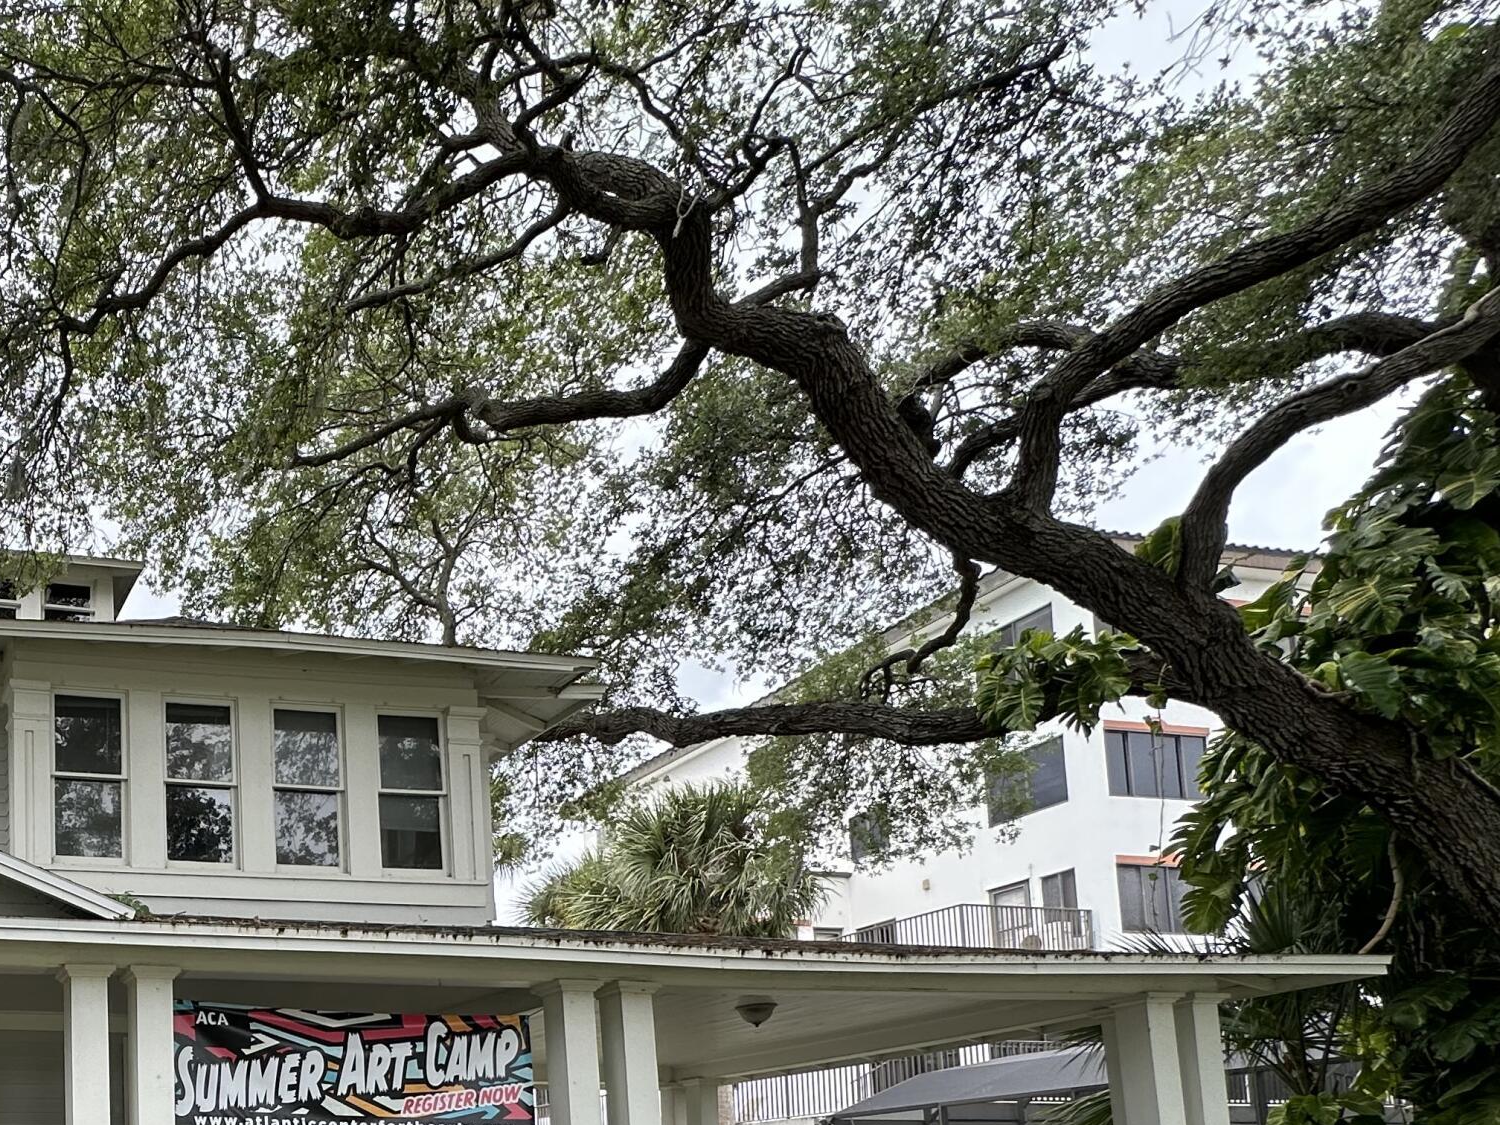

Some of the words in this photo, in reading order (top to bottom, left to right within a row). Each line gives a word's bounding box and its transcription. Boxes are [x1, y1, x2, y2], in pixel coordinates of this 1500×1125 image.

[195, 1010, 229, 1026] ACA
[174, 1045, 325, 1117] SUMMER
[336, 1031, 414, 1097] ART
[426, 1020, 519, 1087] CAMP
[402, 1089, 476, 1115] REGISTER
[480, 1084, 523, 1105] NOW
